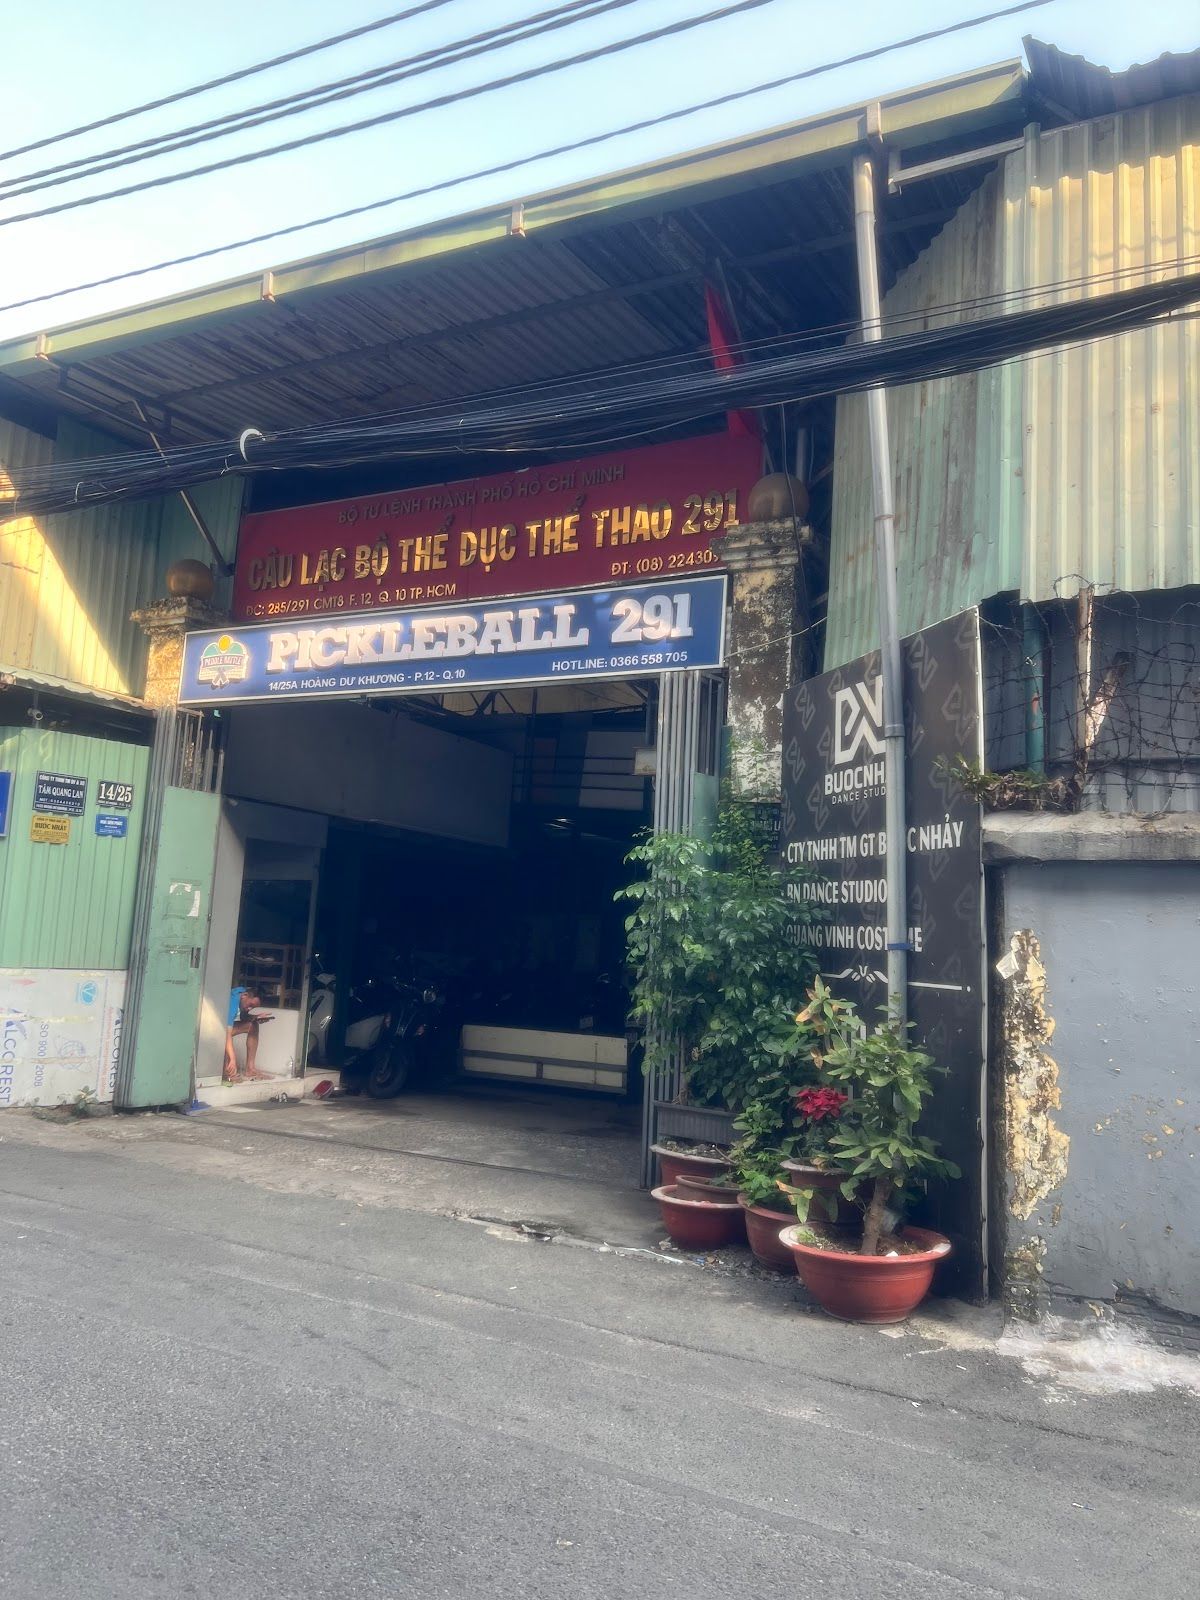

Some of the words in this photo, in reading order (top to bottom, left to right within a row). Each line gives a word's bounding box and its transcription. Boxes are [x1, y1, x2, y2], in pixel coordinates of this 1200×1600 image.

[547, 473, 575, 492] CHÍ
[582, 464, 625, 486] MINH
[300, 547, 347, 591] LẠC
[354, 531, 389, 585] BỘ
[399, 513, 455, 573] THỂ
[459, 523, 517, 572] DỤC
[525, 493, 587, 558] THỂ
[592, 499, 673, 548] THAO
[681, 487, 740, 536] 291
[611, 561, 632, 576] ĐT:
[636, 556, 663, 574] (08)
[268, 599, 310, 615] 285/291
[314, 595, 344, 610] CMT8
[379, 590, 392, 603] Q.
[395, 585, 407, 600] 10
[266, 604, 590, 674] PICKLEBALL
[611, 593, 694, 644] 291
[552, 658, 608, 672] HOTLINE:
[610, 653, 639, 668] 0366
[641, 652, 663, 665] 558
[665, 651, 688, 663] 705
[268, 681, 298, 691] 14/25A
[301, 675, 336, 690] HOÀNG
[340, 675, 356, 687] DƯ
[358, 672, 405, 686] KHƯƠNG
[415, 671, 434, 682] P.12
[443, 669, 465, 680] Q.10
[824, 761, 886, 796] BUOCNH
[52, 787, 72, 798] QUANG
[99, 782, 132, 803] 14/25
[831, 789, 860, 805] DANCE
[863, 786, 886, 799] STUD
[787, 840, 805, 863] CTY
[807, 837, 837, 862] TNHH
[840, 835, 857, 859] TM
[860, 832, 875, 857] GT
[878, 827, 916, 856] BC
[919, 813, 964, 851] NHẢY
[787, 883, 801, 903] BN
[803, 881, 838, 904] DANCE
[841, 878, 888, 904] STUDIO
[825, 925, 854, 949] VINH
[857, 926, 922, 952] COSTE
